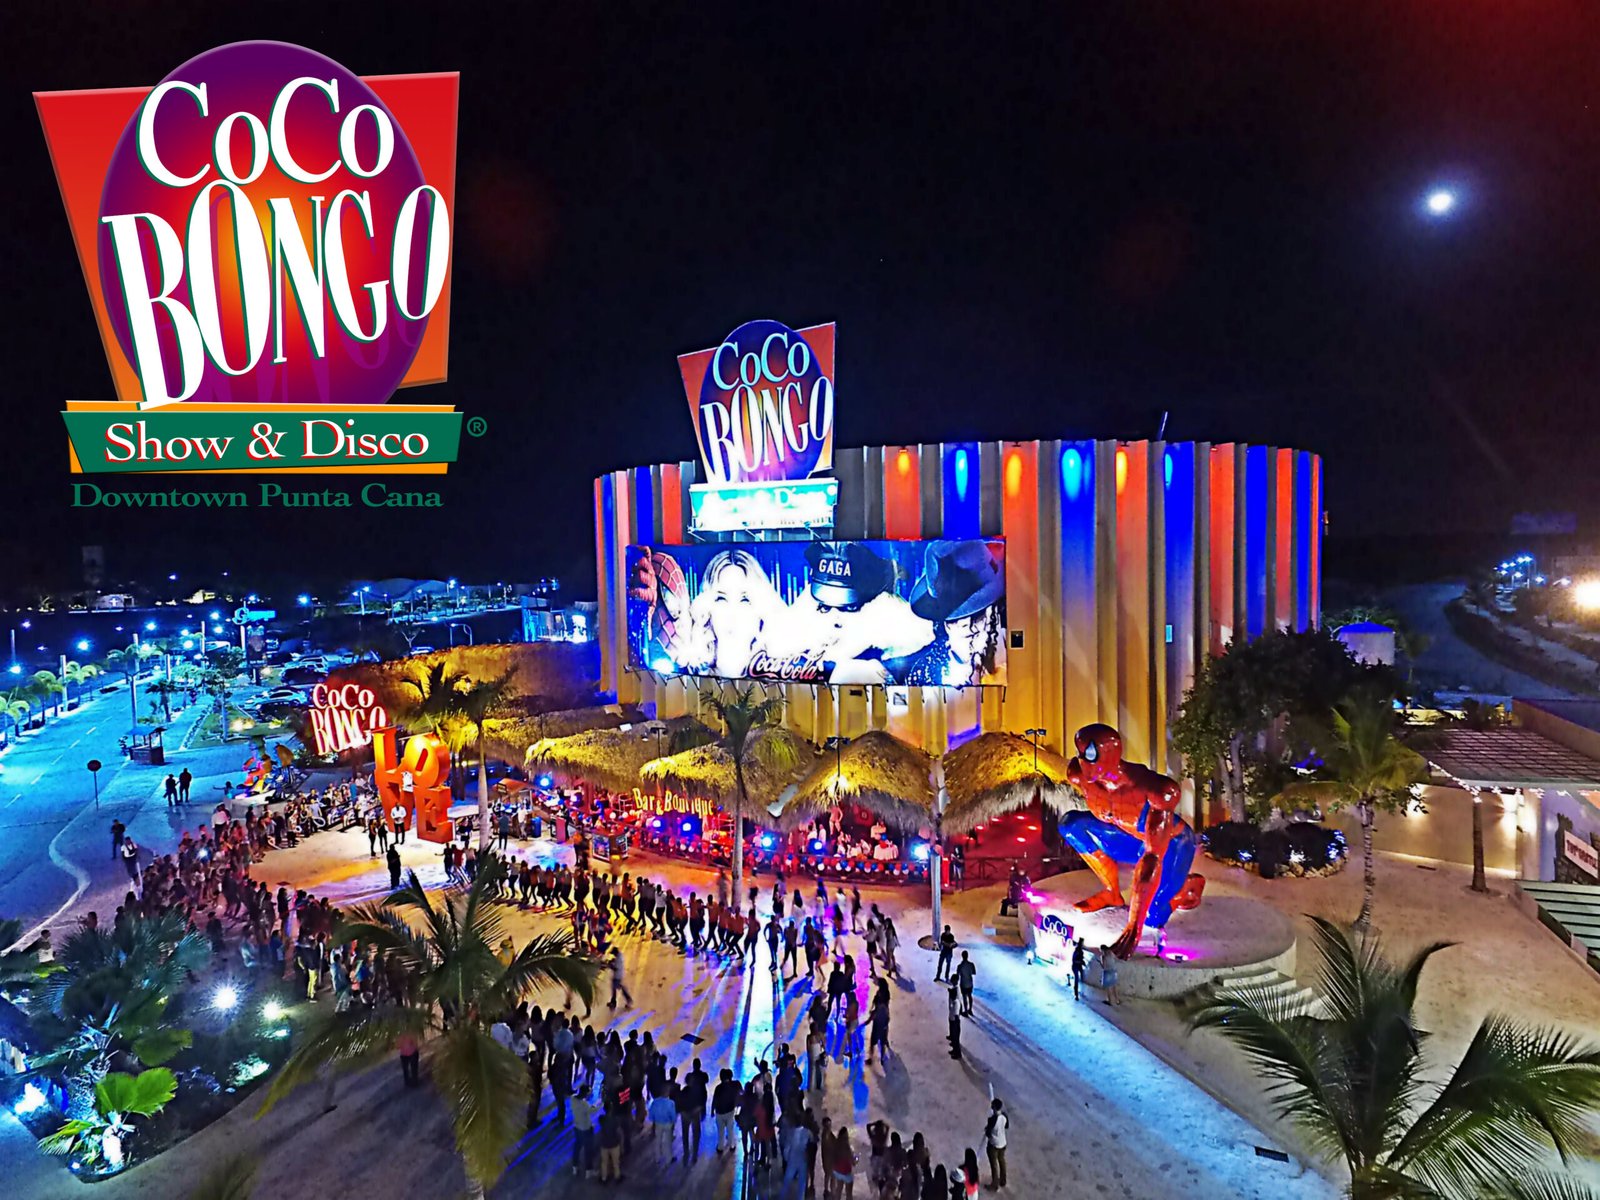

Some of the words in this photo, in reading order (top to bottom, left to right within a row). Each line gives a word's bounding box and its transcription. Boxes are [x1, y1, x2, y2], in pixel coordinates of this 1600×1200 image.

[712, 332, 810, 391] CoCo
[700, 376, 834, 483] BONGO
[819, 559, 851, 577] GAGA
[313, 683, 375, 710] CoCo
[309, 706, 386, 756] BONGO
[632, 787, 655, 811] Bar
[1042, 916, 1068, 937] CoCo
